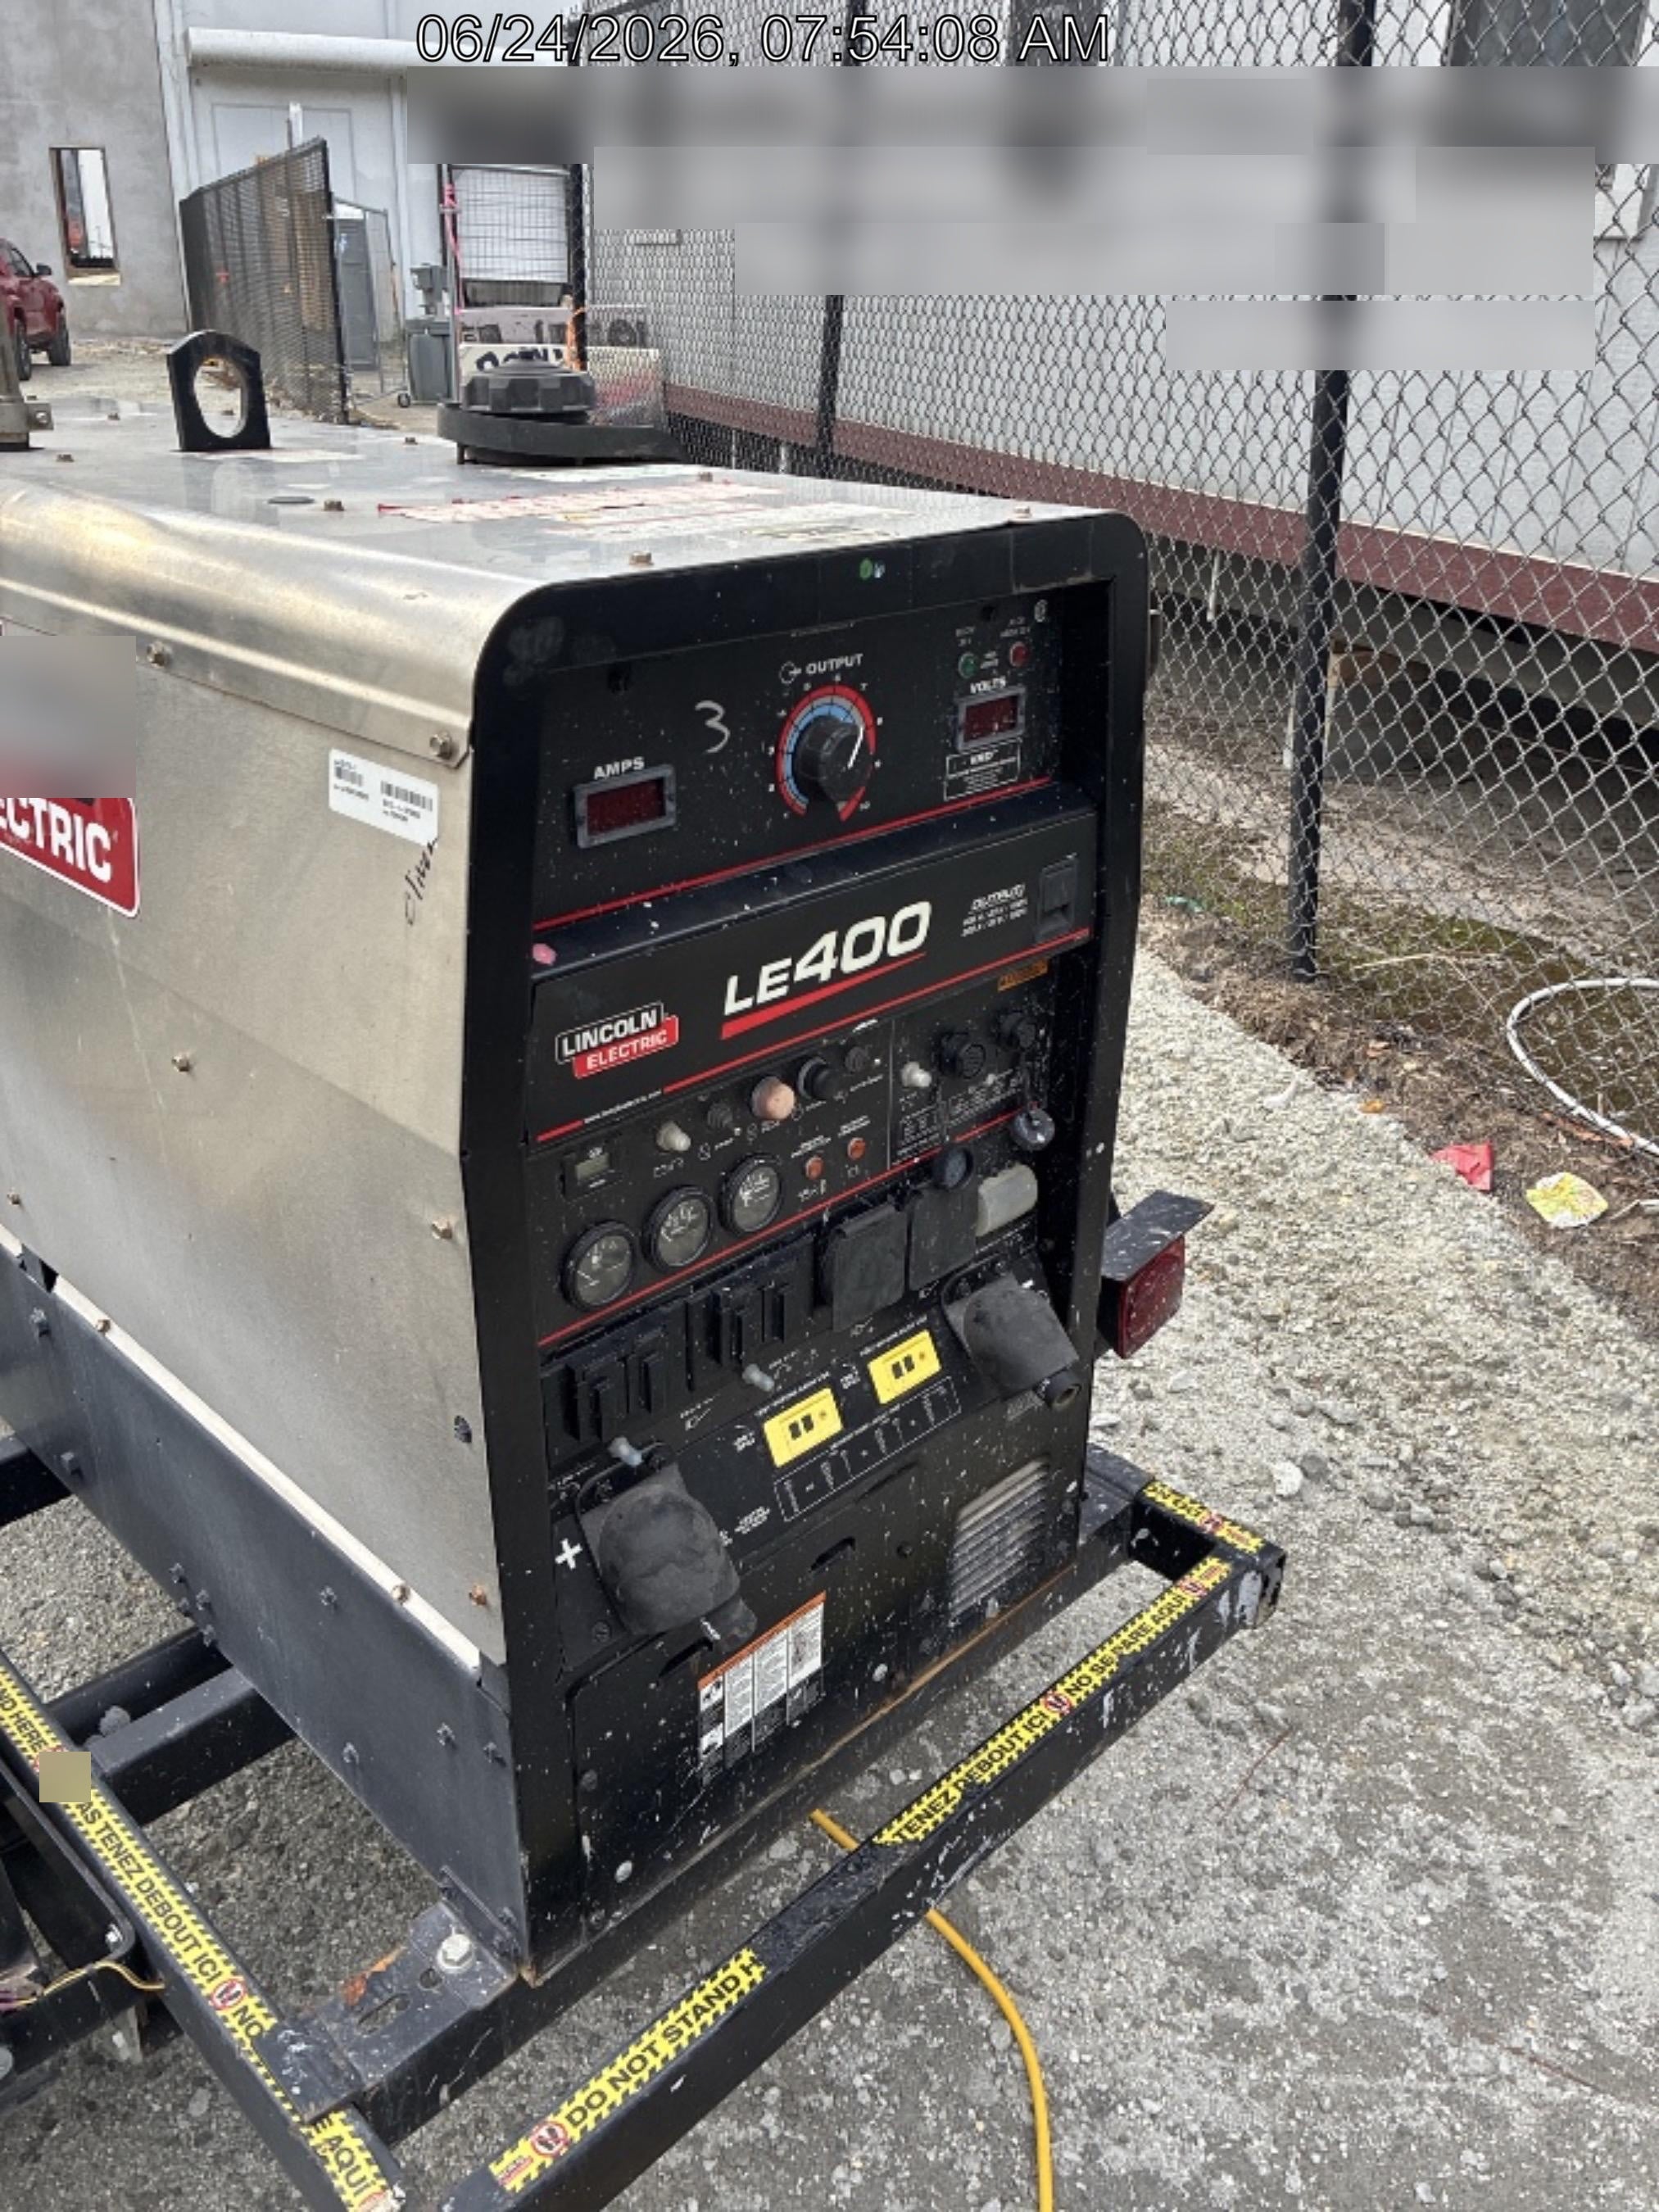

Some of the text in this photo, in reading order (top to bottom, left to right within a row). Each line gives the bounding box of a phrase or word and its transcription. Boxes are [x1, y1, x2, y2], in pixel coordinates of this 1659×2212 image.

[806, 653, 863, 675] OUTPUT
[970, 675, 1007, 695] VOLTS
[694, 700, 731, 754] 3
[594, 755, 646, 780] AMPS
[724, 901, 932, 1016] LE400
[561, 1008, 658, 1058] LINCOLN
[586, 1029, 668, 1070] ELECTRIC
[1064, 1674, 1092, 1697] NO
[14, 1710, 49, 1753] HERE
[1023, 1711, 1050, 1734] ICI
[94, 1821, 146, 1881] TENEZ
[135, 1874, 202, 1957] DEBOUT
[193, 1950, 223, 1983] ICI
[564, 2090, 609, 2128] DO
[606, 2041, 661, 2093] NOT
[662, 1974, 741, 2045] STAND
